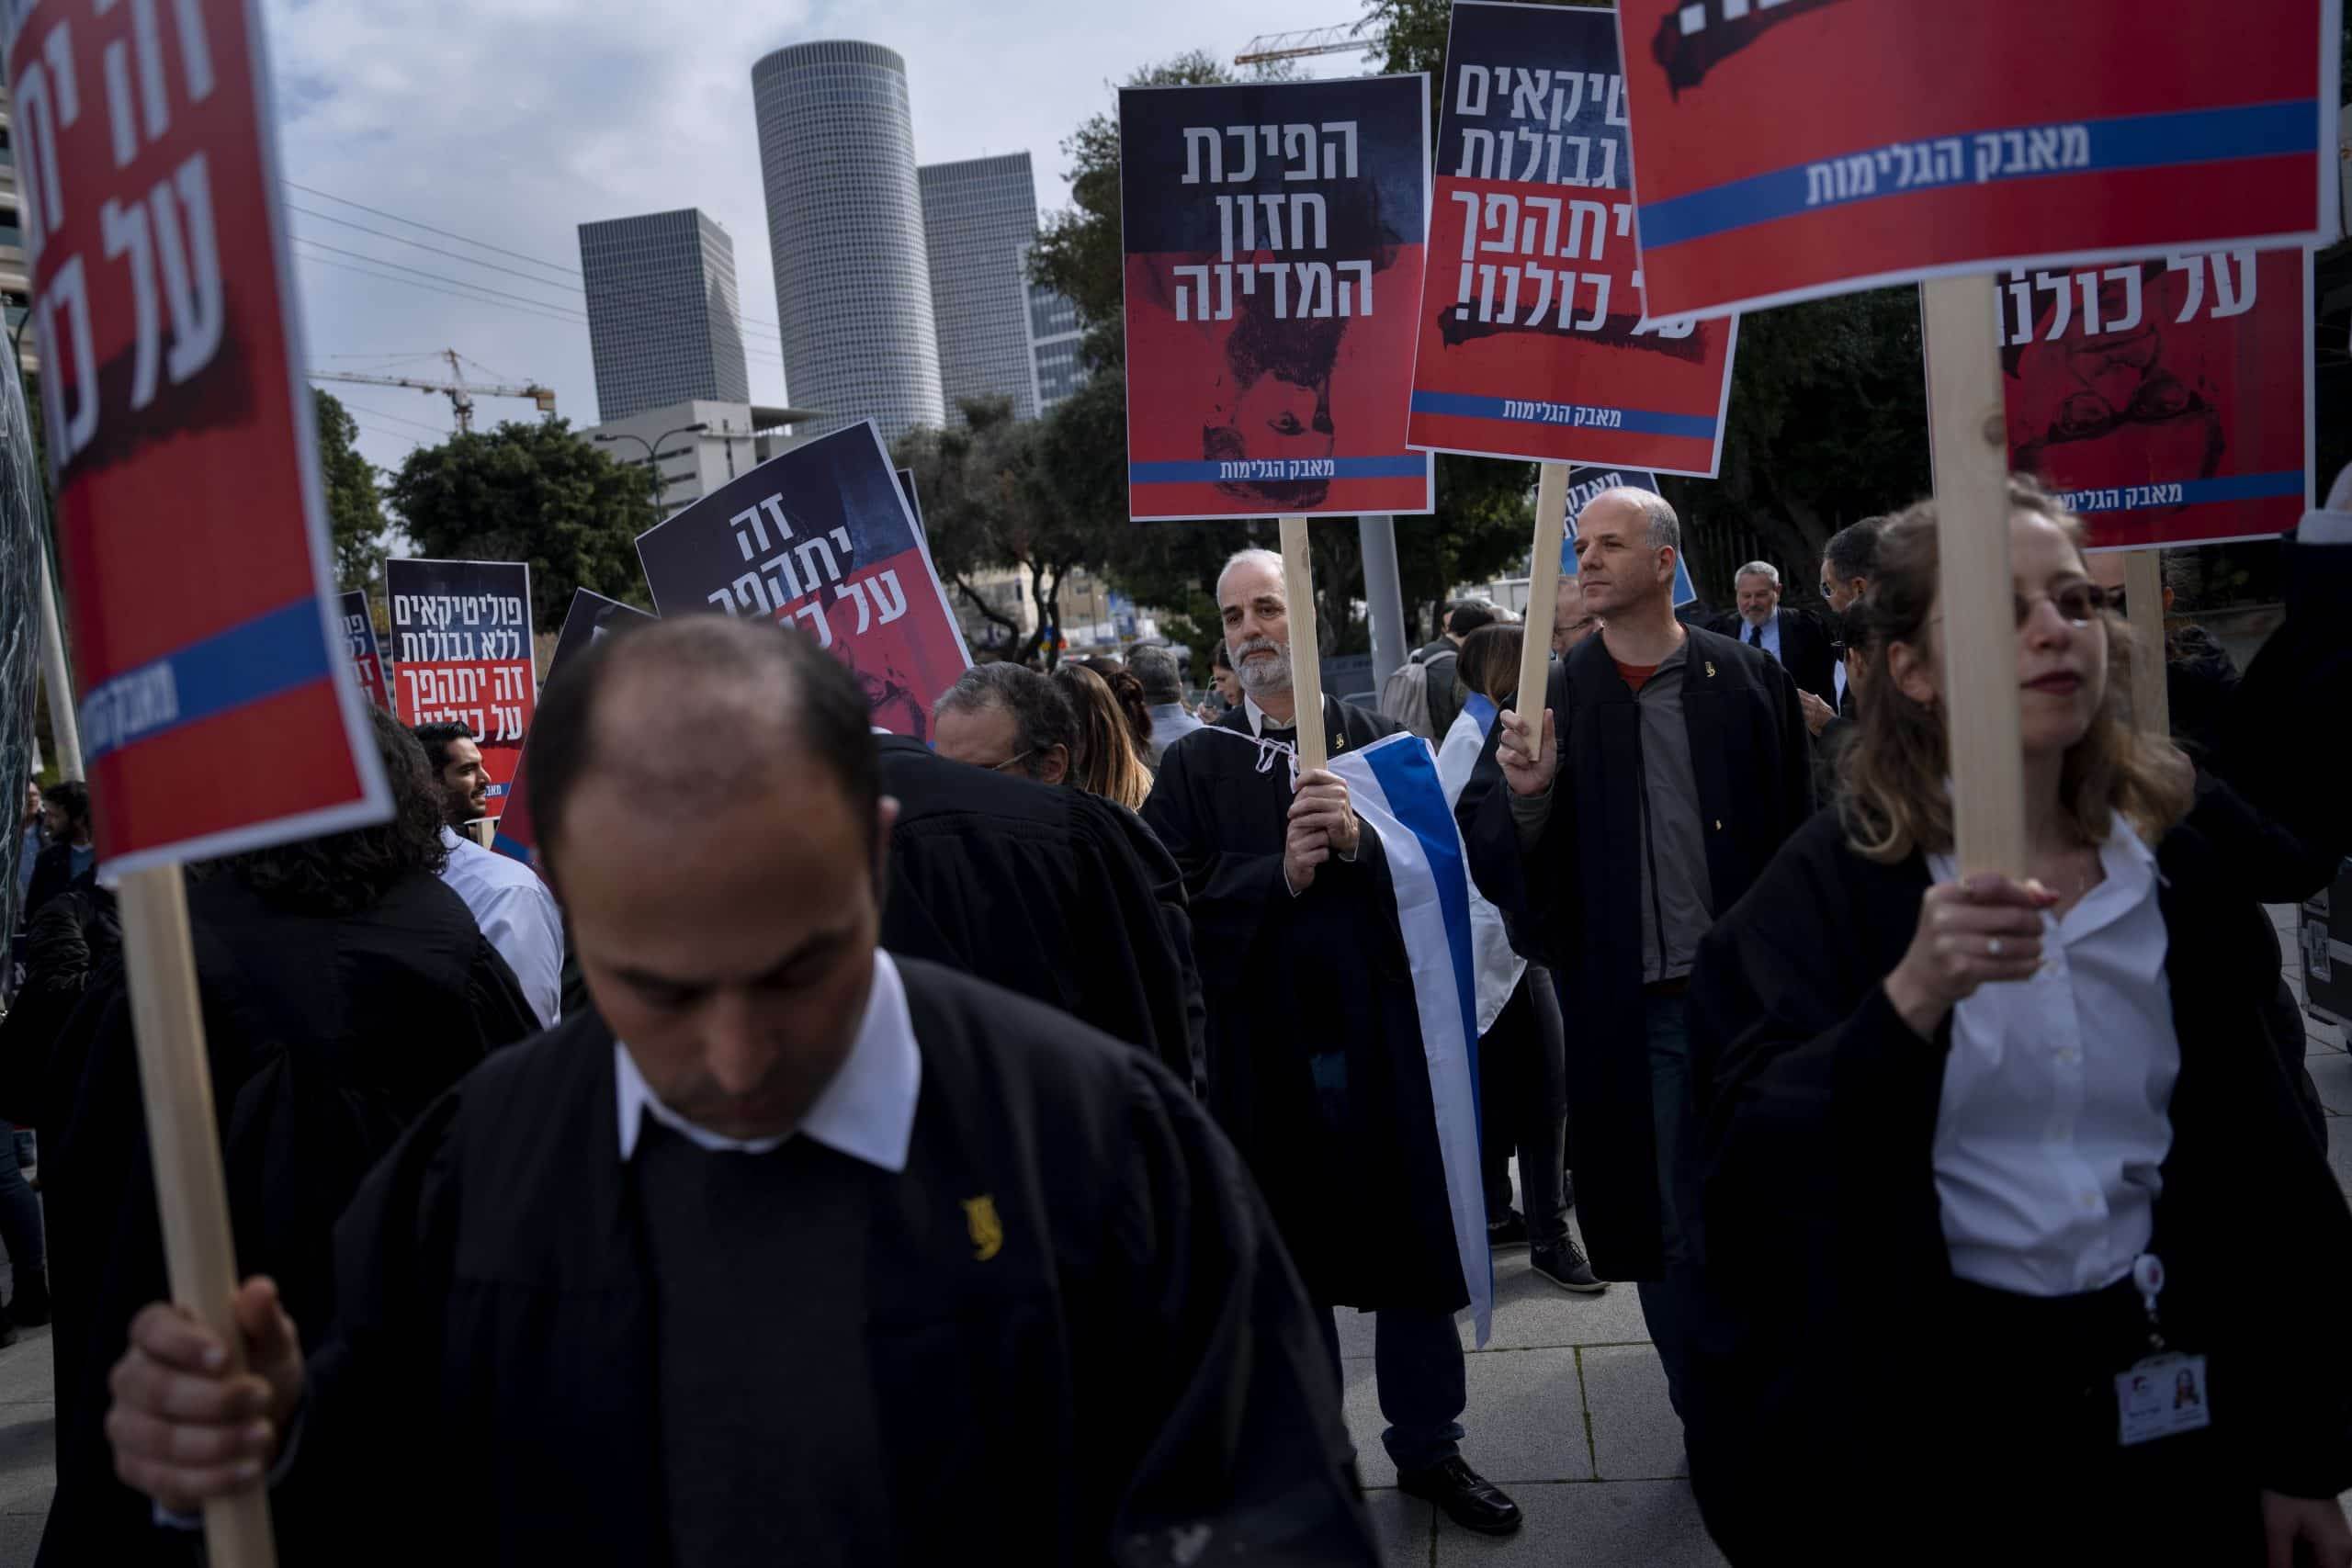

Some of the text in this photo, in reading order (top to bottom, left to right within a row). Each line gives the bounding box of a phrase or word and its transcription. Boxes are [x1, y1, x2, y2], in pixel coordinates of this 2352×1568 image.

[1182, 120, 1358, 184] הפיכת
[1454, 126, 1618, 189] גבולות
[1806, 124, 2090, 206] מאבק הגלימות
[1215, 193, 1328, 263] חזון
[1452, 190, 1633, 262] יתהפך
[99, 150, 223, 412] על
[1173, 260, 1374, 321] המדינה
[1455, 261, 1611, 332] כולנו!
[2165, 250, 2256, 323] על
[1502, 400, 1622, 427] מאבק הגלימות
[1219, 459, 1335, 480] מאבק הגלימות
[2125, 483, 2183, 510] מאבק
[729, 491, 794, 562] זה
[394, 593, 523, 632] פוליטיקאים
[833, 569, 908, 636] על
[401, 628, 521, 662] ללא גבולות
[402, 667, 487, 712] יתהפך
[493, 666, 525, 701] זה
[491, 704, 524, 742] על
